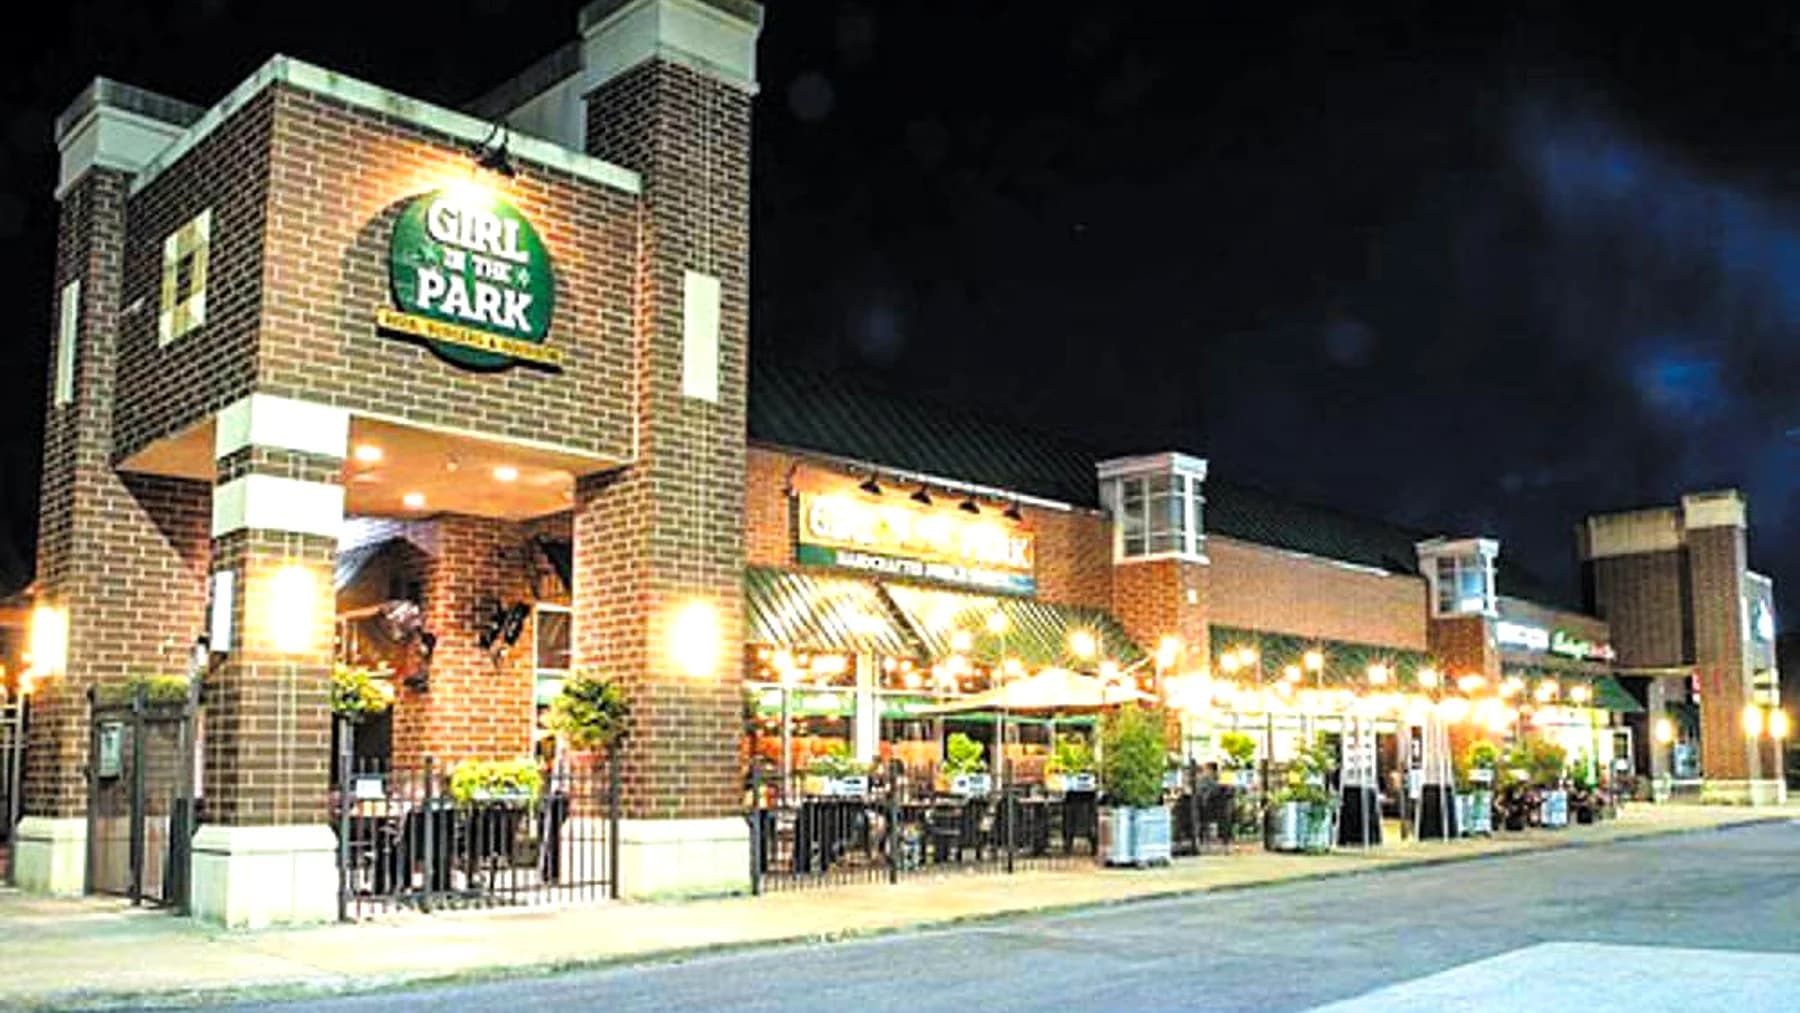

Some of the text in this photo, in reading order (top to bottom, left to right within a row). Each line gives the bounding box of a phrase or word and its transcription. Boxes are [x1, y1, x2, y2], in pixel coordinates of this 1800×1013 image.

[428, 198, 529, 263] GIRL
[444, 247, 513, 283] IN THE
[416, 268, 533, 334] PARK
